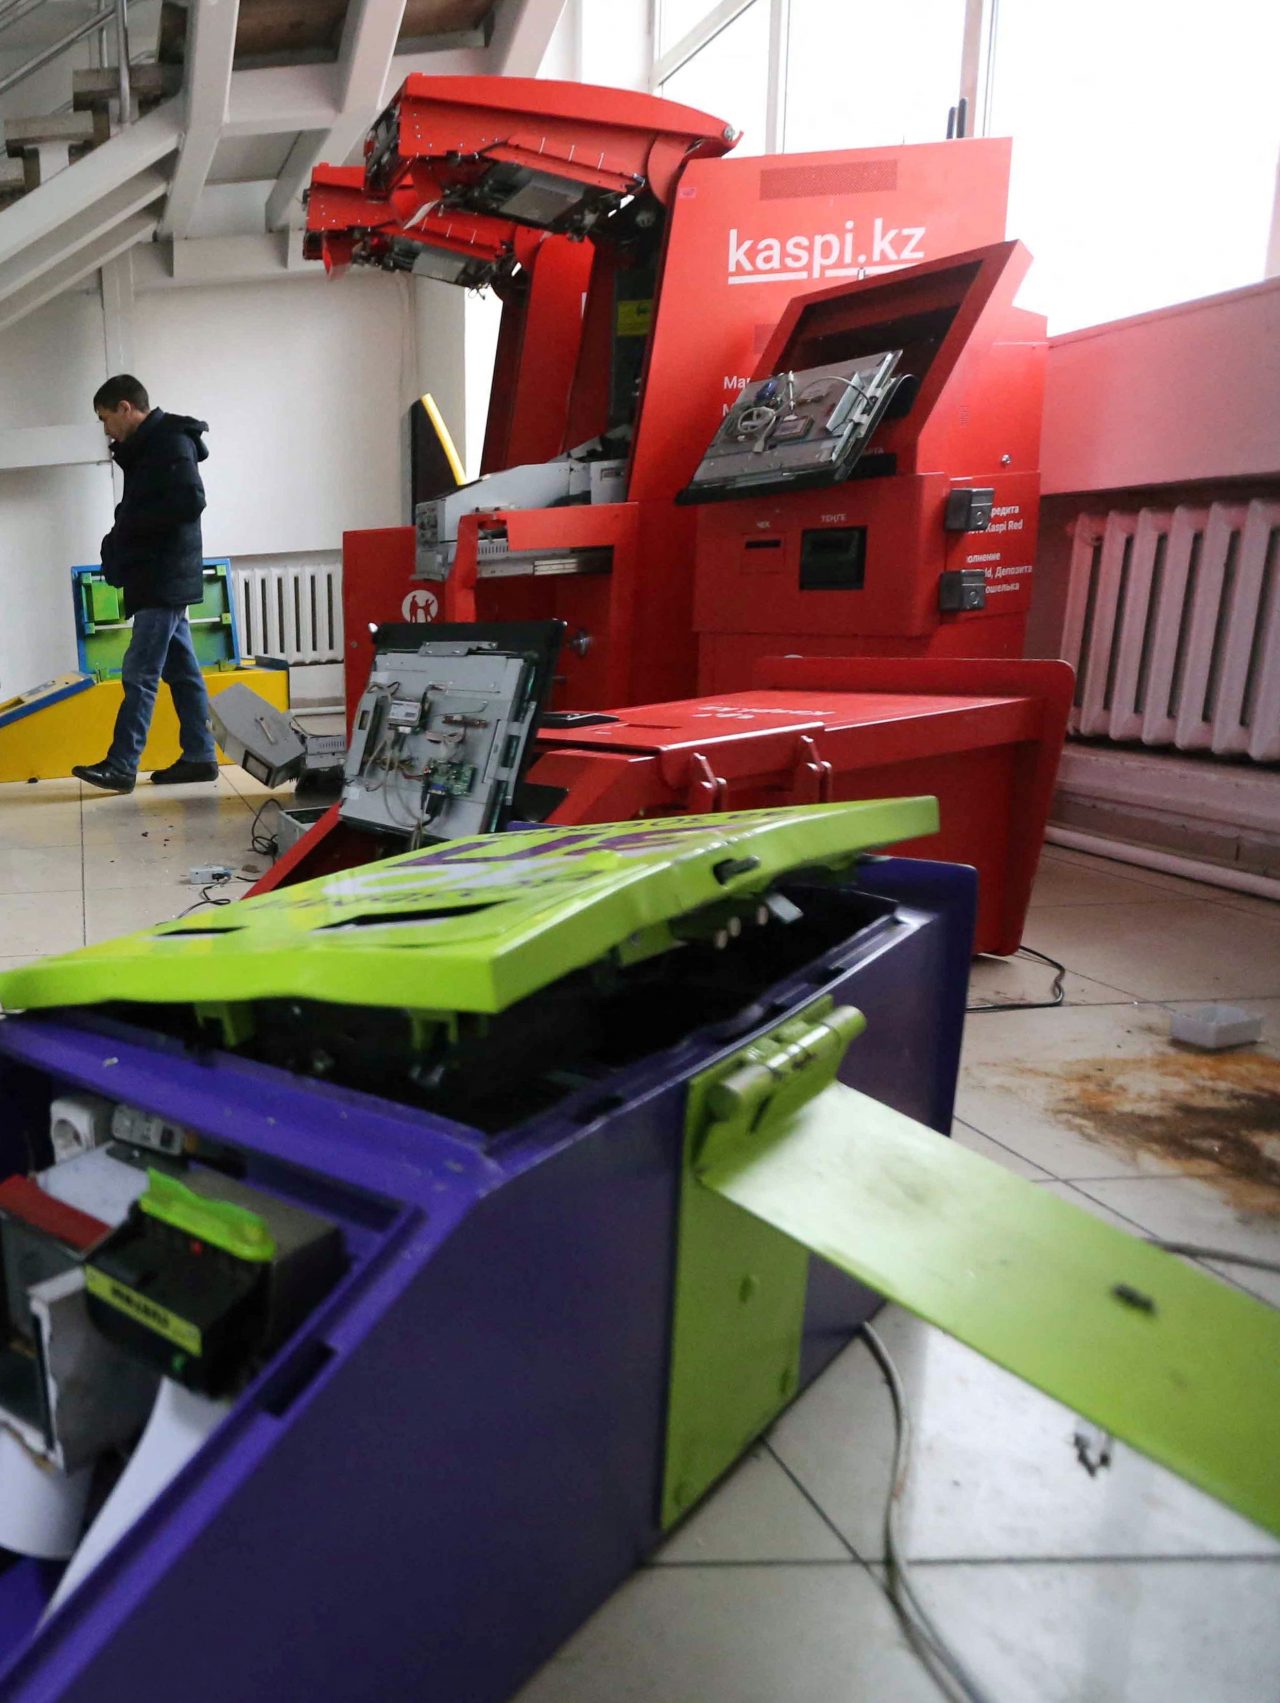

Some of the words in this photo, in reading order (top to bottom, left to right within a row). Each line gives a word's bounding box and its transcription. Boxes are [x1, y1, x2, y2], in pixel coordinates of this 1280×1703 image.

[728, 218, 926, 279] kaspi.kz
[991, 505, 1019, 518] редита
[1008, 519, 1024, 531] Red
[967, 553, 1001, 564] олнение
[995, 566, 1032, 578] Депозита
[985, 583, 1020, 594] ошелька
